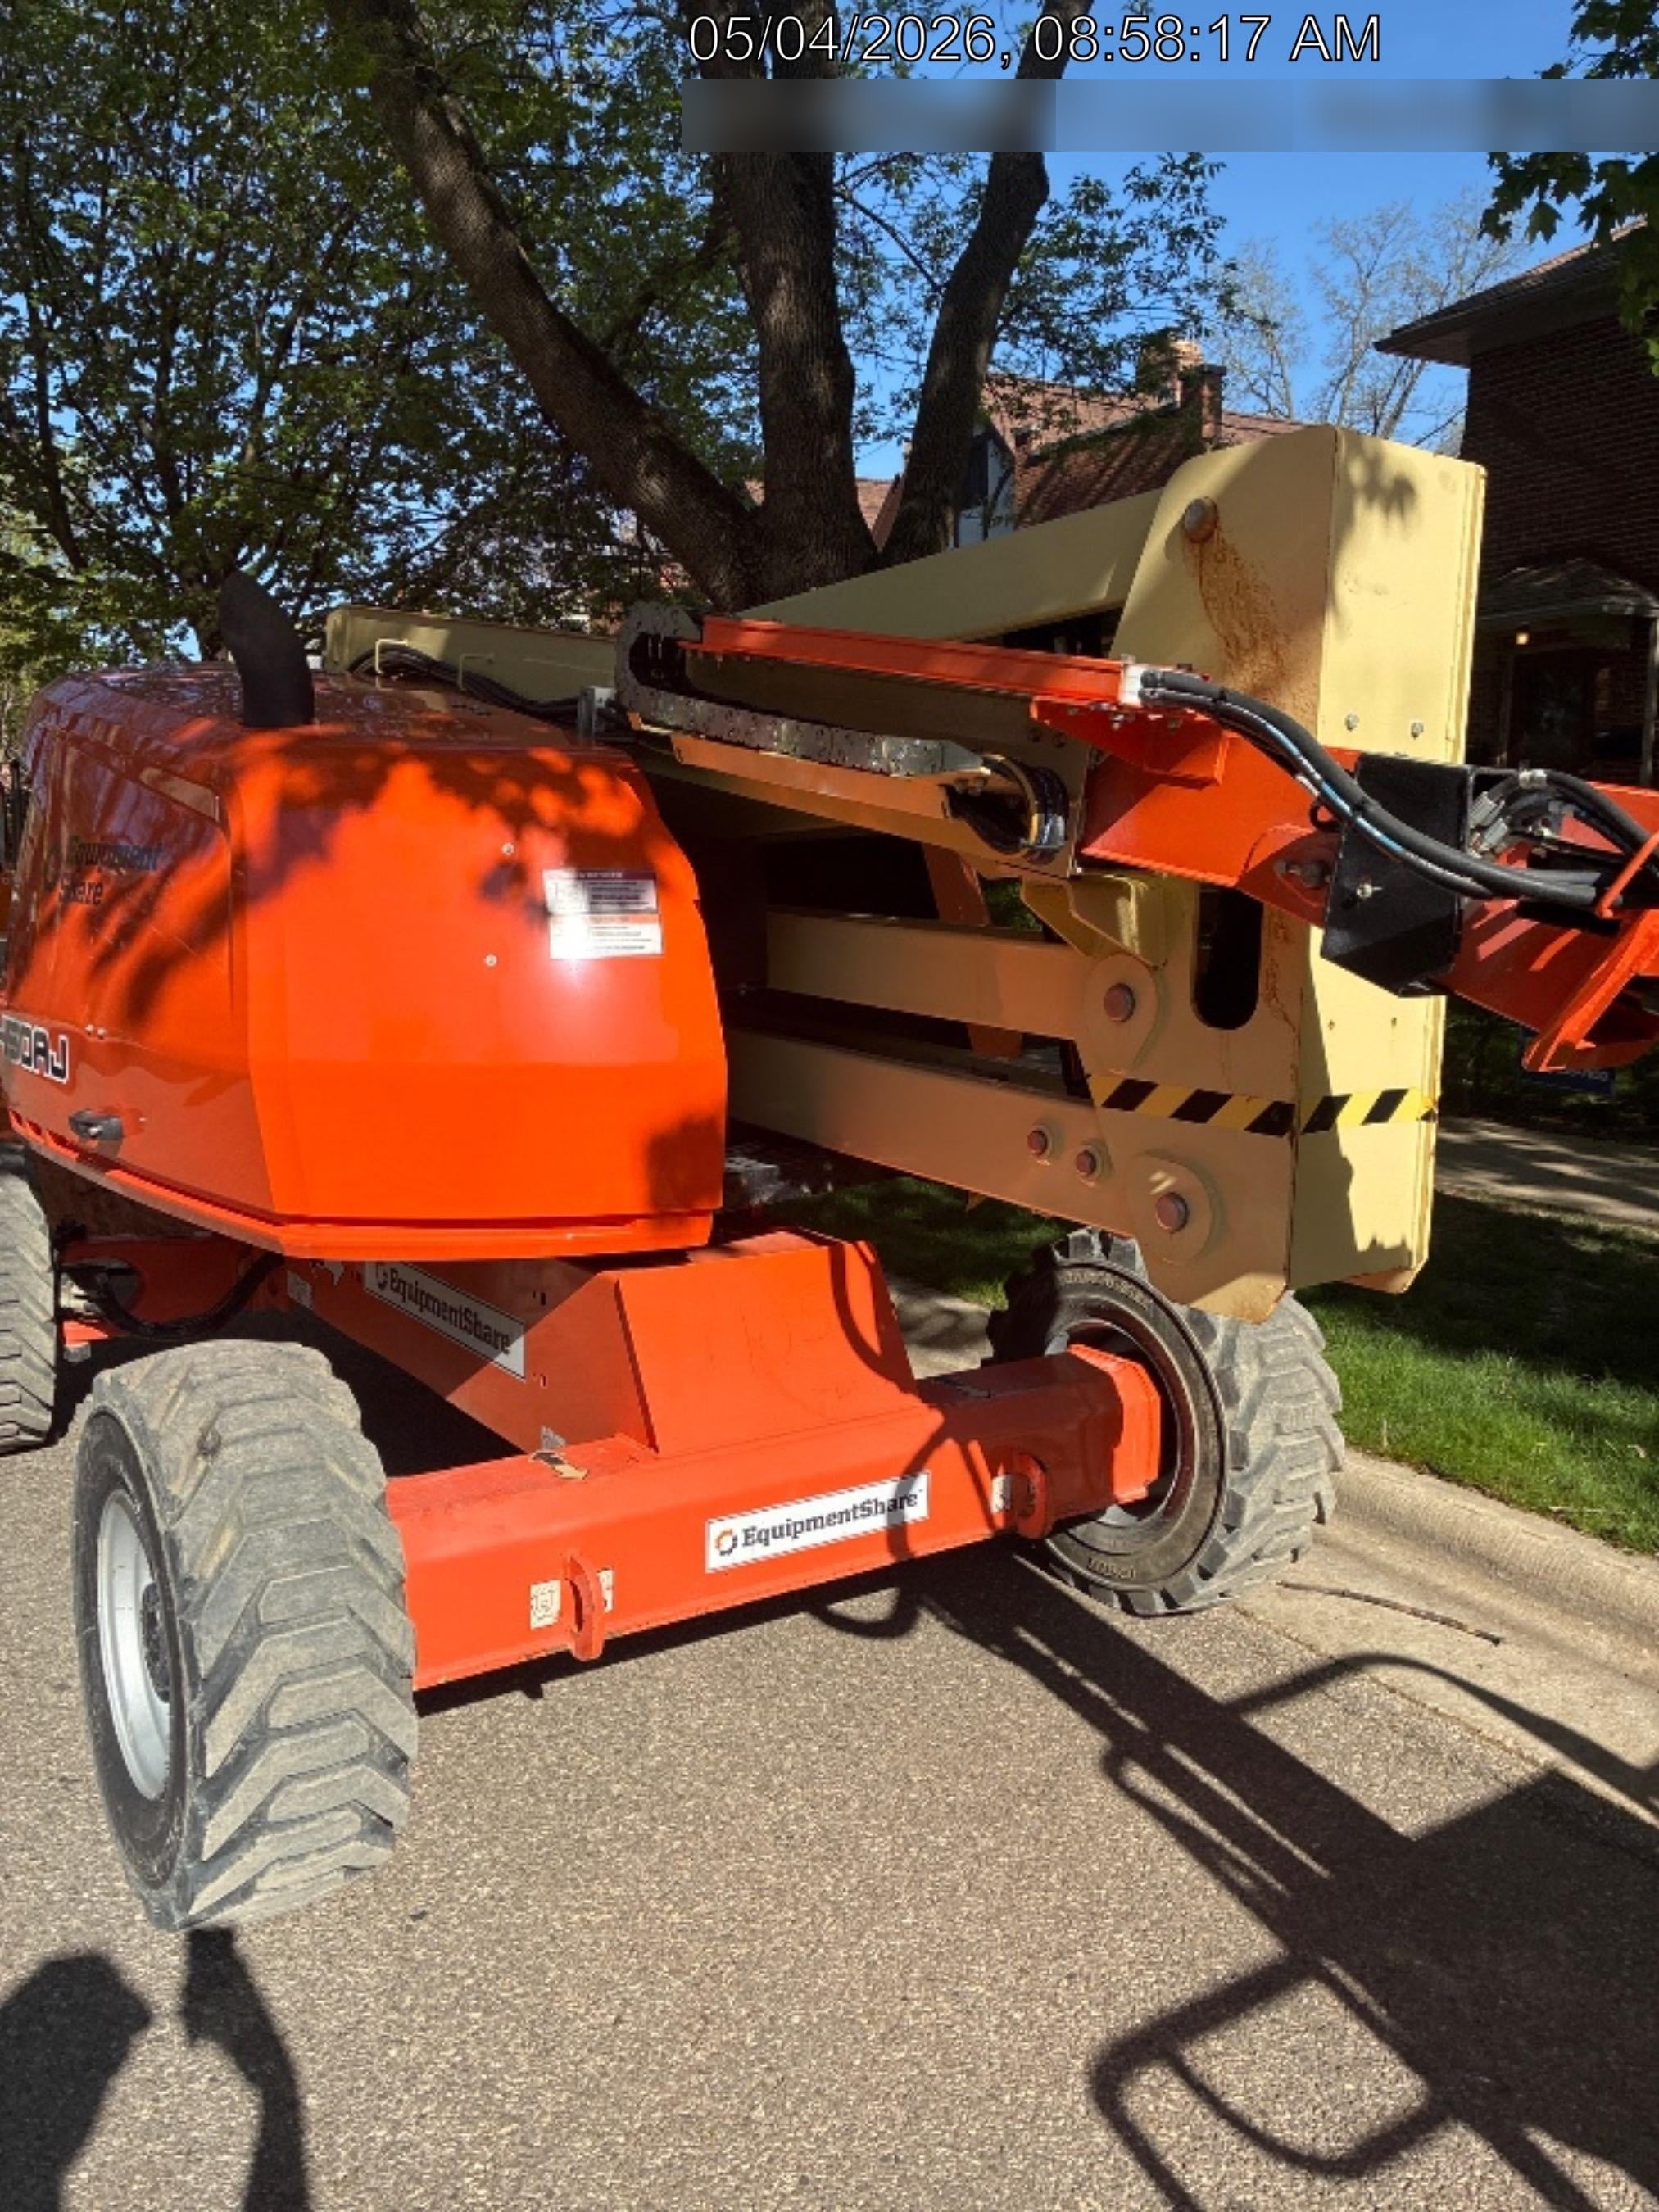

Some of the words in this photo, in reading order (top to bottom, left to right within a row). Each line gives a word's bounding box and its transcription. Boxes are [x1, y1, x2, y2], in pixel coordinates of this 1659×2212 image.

[0, 1014, 69, 1084] 50AJ
[389, 1267, 510, 1356] EquipmentShare
[741, 1492, 918, 1548] EquipmentShare
